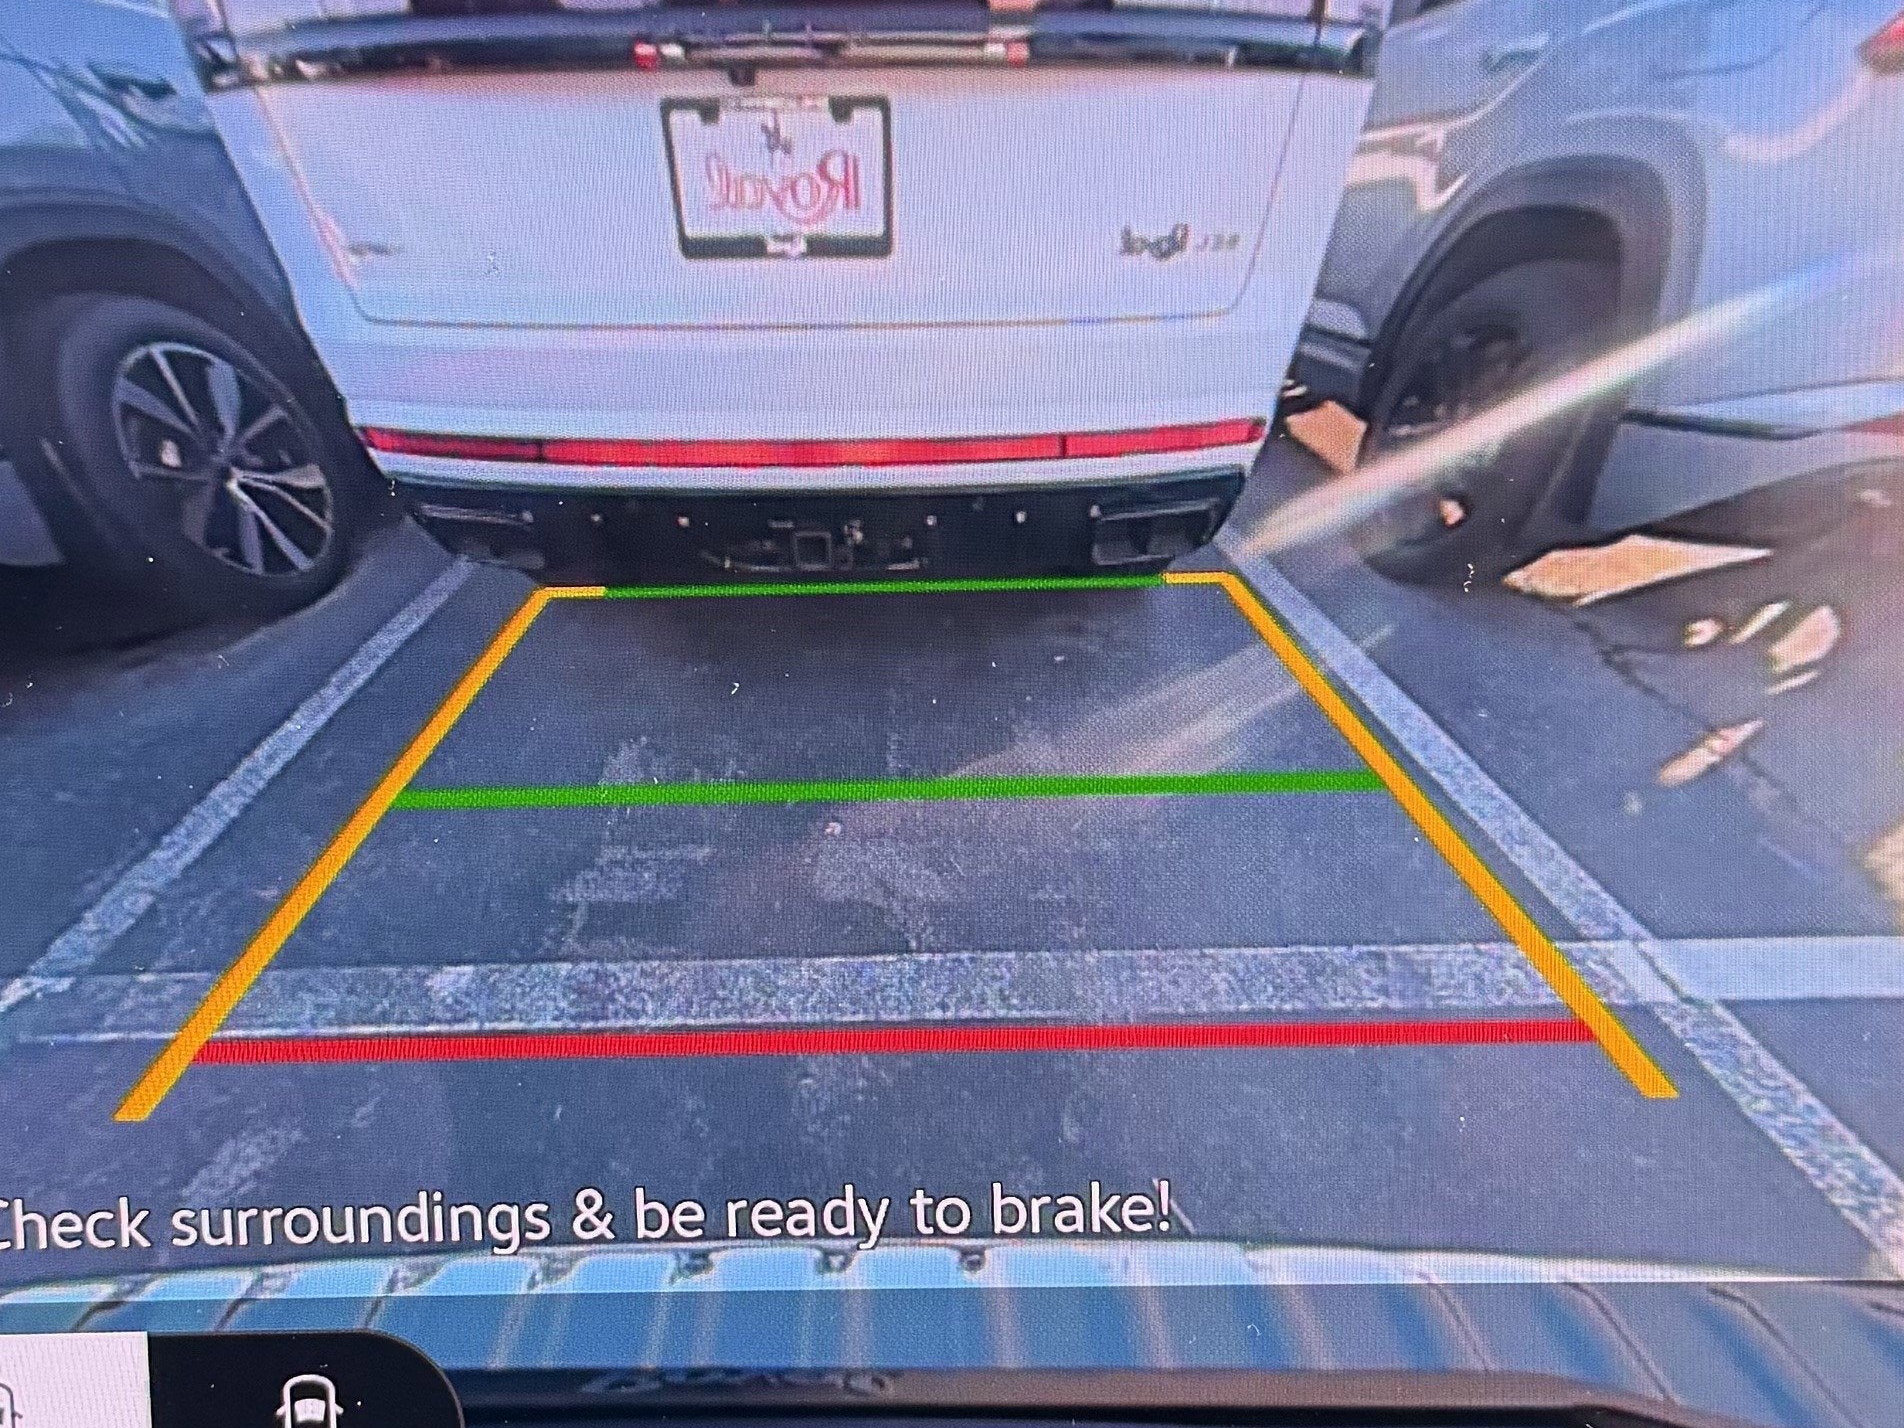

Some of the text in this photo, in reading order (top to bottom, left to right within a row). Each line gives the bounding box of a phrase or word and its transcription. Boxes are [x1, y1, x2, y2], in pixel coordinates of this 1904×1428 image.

[170, 1189, 552, 1256] surroundings
[571, 1186, 615, 1241] &
[634, 1185, 706, 1239] be
[726, 1183, 891, 1250] ready
[910, 1187, 970, 1236] to
[991, 1180, 1172, 1234] brake!
